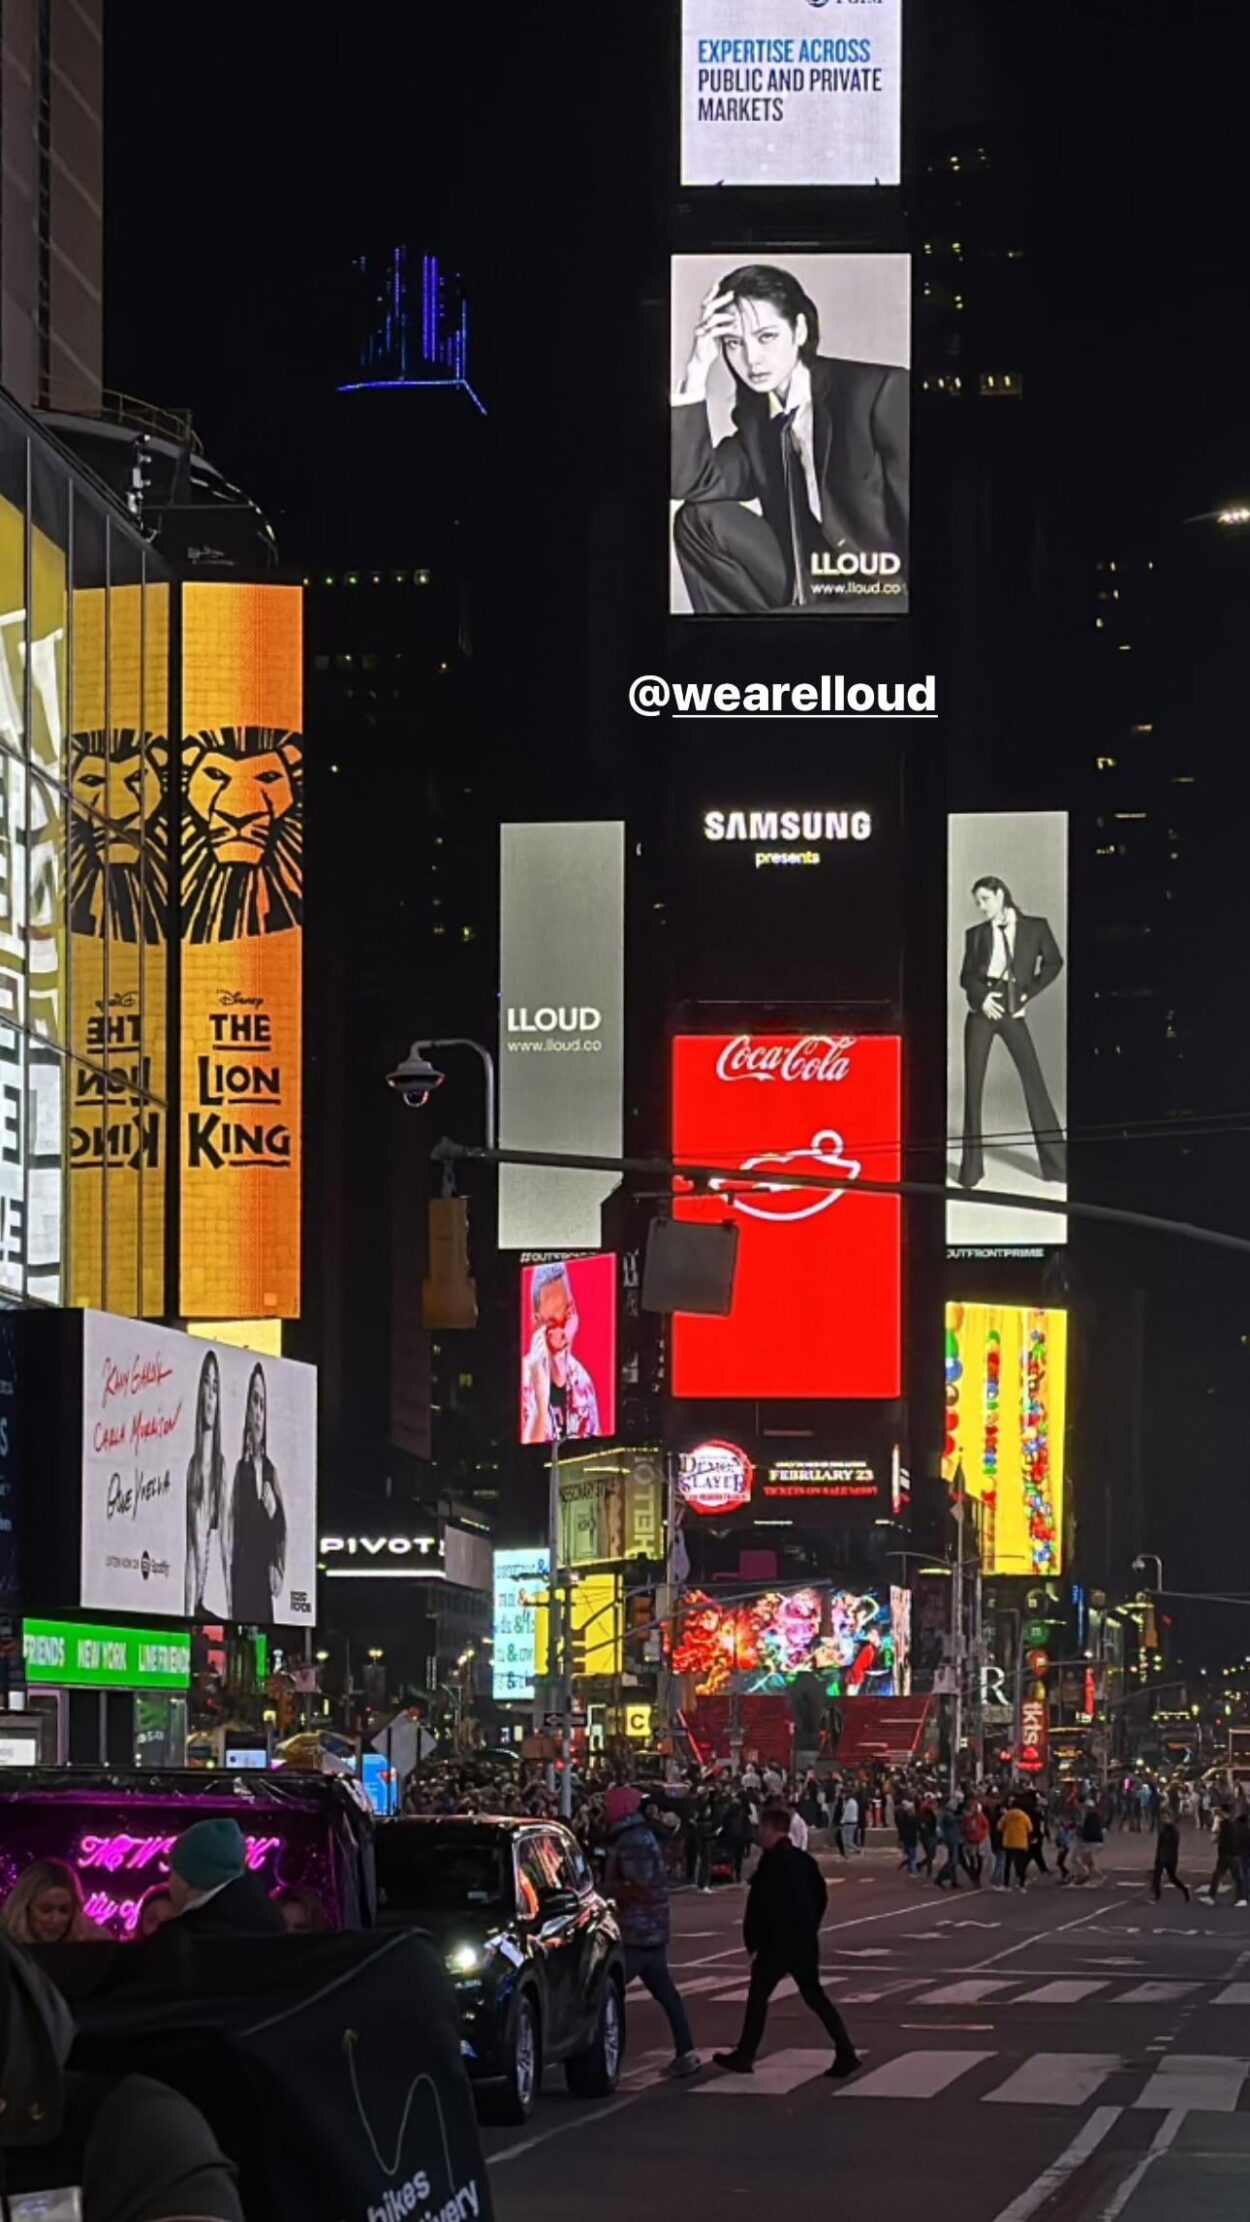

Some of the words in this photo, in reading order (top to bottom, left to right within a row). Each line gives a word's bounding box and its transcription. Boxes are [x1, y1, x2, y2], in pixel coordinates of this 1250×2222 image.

[698, 38, 794, 63] EXPERTISE
[799, 38, 871, 63] ACROSS
[698, 68, 763, 93] PUBLIC
[767, 68, 804, 92] AND
[809, 68, 882, 92] PRIVATE
[698, 97, 783, 121] MARKETS
[811, 552, 900, 576] LLOUD
[811, 580, 900, 595] www.lloud.co
[704, 811, 871, 840] SAMSUNG
[755, 851, 820, 868] presents
[507, 1007, 602, 1032] LLOUD
[209, 1014, 271, 1051] THE
[507, 1038, 602, 1052] www.lloud.co
[768, 1470, 853, 1481] FEBRUARY
[855, 1470, 874, 1481] 23
[77, 1639, 99, 1669] NEW
[102, 1641, 127, 1671] YORK
[1022, 1702, 1042, 1745] tkts
